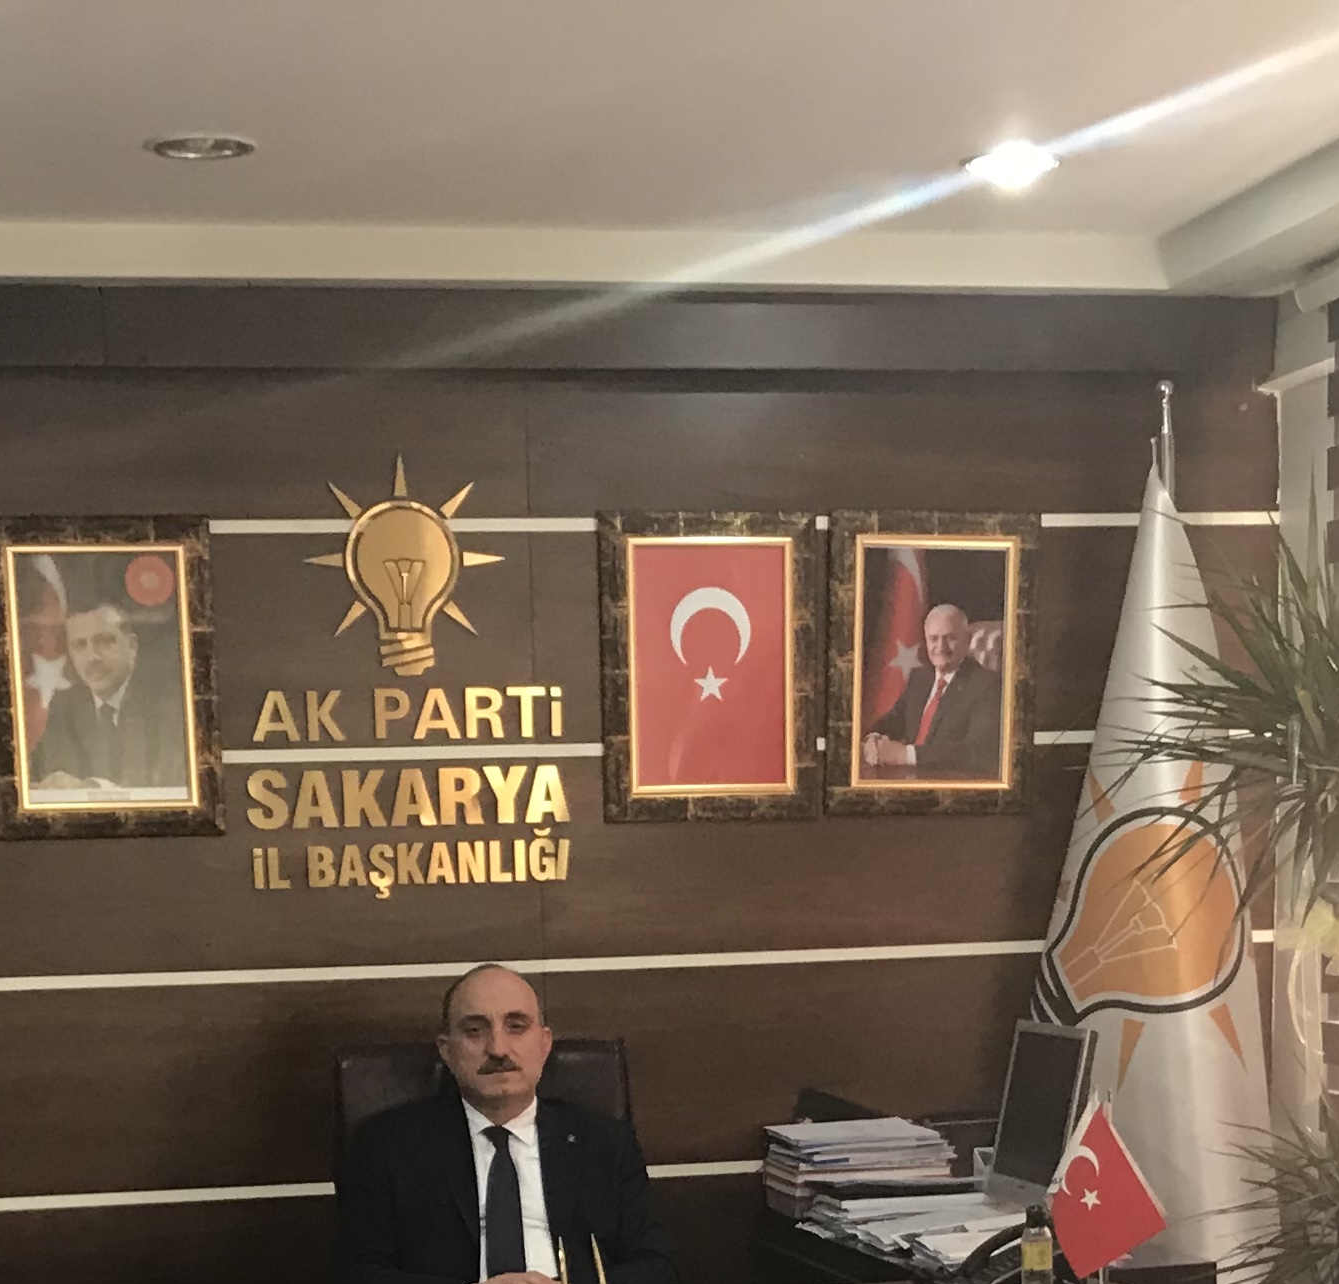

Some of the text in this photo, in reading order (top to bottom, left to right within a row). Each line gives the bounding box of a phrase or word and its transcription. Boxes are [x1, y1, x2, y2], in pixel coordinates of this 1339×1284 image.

[252, 689, 346, 742] AK
[246, 765, 571, 830] SAKARYA
[307, 828, 571, 899] BAŞKANLIĞI
